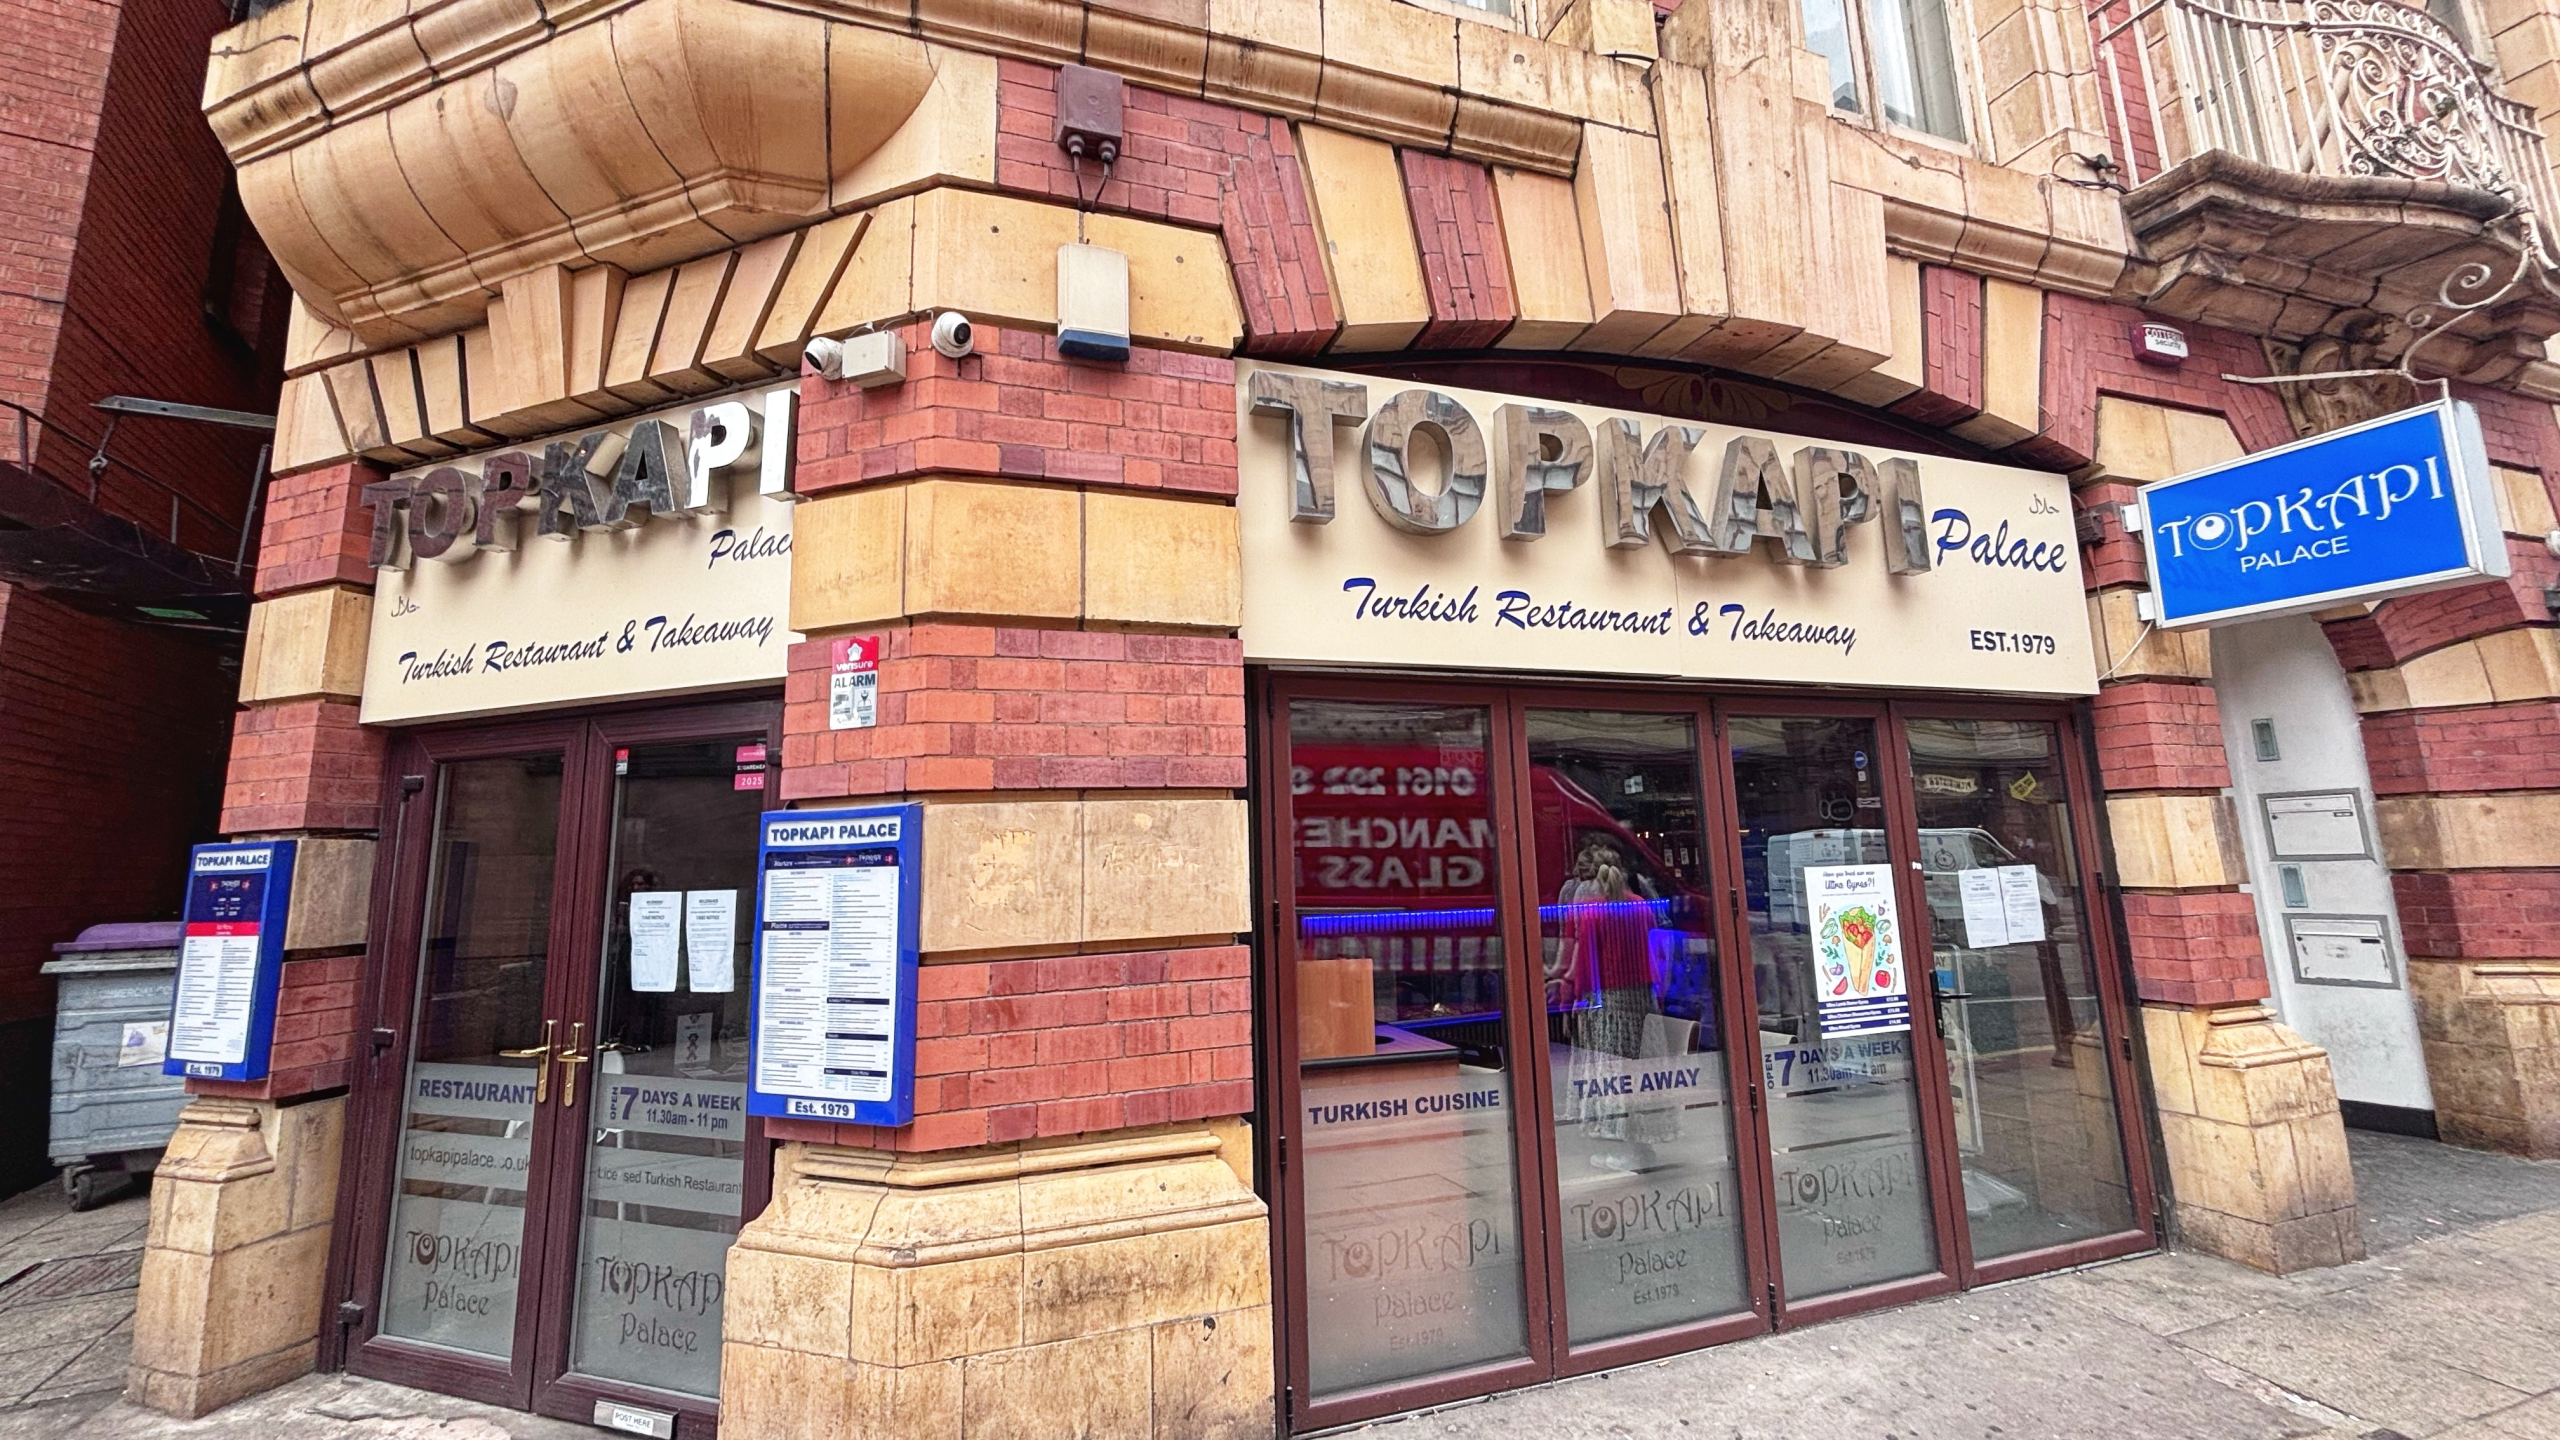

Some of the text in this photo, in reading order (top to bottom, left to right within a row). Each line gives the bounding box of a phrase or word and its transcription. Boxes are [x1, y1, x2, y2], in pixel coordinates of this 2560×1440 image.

[361, 388, 798, 572] TOPKAPI
[1248, 369, 1931, 578] TOPKAPI
[2158, 456, 2445, 558] TOPKAPI
[708, 526, 792, 569] Palac
[1931, 508, 2067, 573] Palace
[2240, 535, 2350, 572] PALACE
[1342, 577, 1859, 656] Turkish Restaurant & Takeaway
[399, 612, 774, 684] Turkish Restaurant & Takeaway
[1970, 630, 2056, 655] EST.1979
[834, 674, 876, 688] ALARM
[836, 660, 874, 672] verisure
[741, 777, 763, 786] 2025
[771, 823, 898, 843] TOPKAPI PALACE
[198, 854, 268, 867] TOPKAPI PALACE
[1825, 879, 1844, 889] Ultra
[204, 1066, 220, 1075] 1979
[1765, 1040, 1903, 1089] OPEN 7 DAYS A WEEK
[1808, 1068, 1852, 1083] 11.30am
[1871, 1063, 1887, 1075] am
[419, 1079, 537, 1105] RESTAURANT
[1573, 1067, 1701, 1099] TAKE AWAY
[610, 1086, 741, 1120] OPEN 7 DAYS A WEEK
[646, 1108, 687, 1126] 11.30am
[697, 1112, 708, 1127] 11
[711, 1117, 728, 1131] pm
[795, 1101, 850, 1117] Est. 1979
[1308, 1089, 1500, 1125] TURKISH CUISINE
[598, 1165, 742, 1195] Licesed Turkish Restaurant
[1570, 1181, 1723, 1242] TOPKAPI
[1823, 1214, 1881, 1247] Palace
[405, 1230, 520, 1283] TOPKAPI
[1319, 1216, 1500, 1283] TOPKAPI
[1618, 1249, 1688, 1285] Palace
[423, 1281, 490, 1316] Palace
[596, 1255, 722, 1317] TOPKAP
[1374, 1291, 1457, 1327] Palace
[620, 1312, 698, 1355] Palace
[615, 1411, 632, 1422] POST
[634, 1417, 651, 1428] HERE
